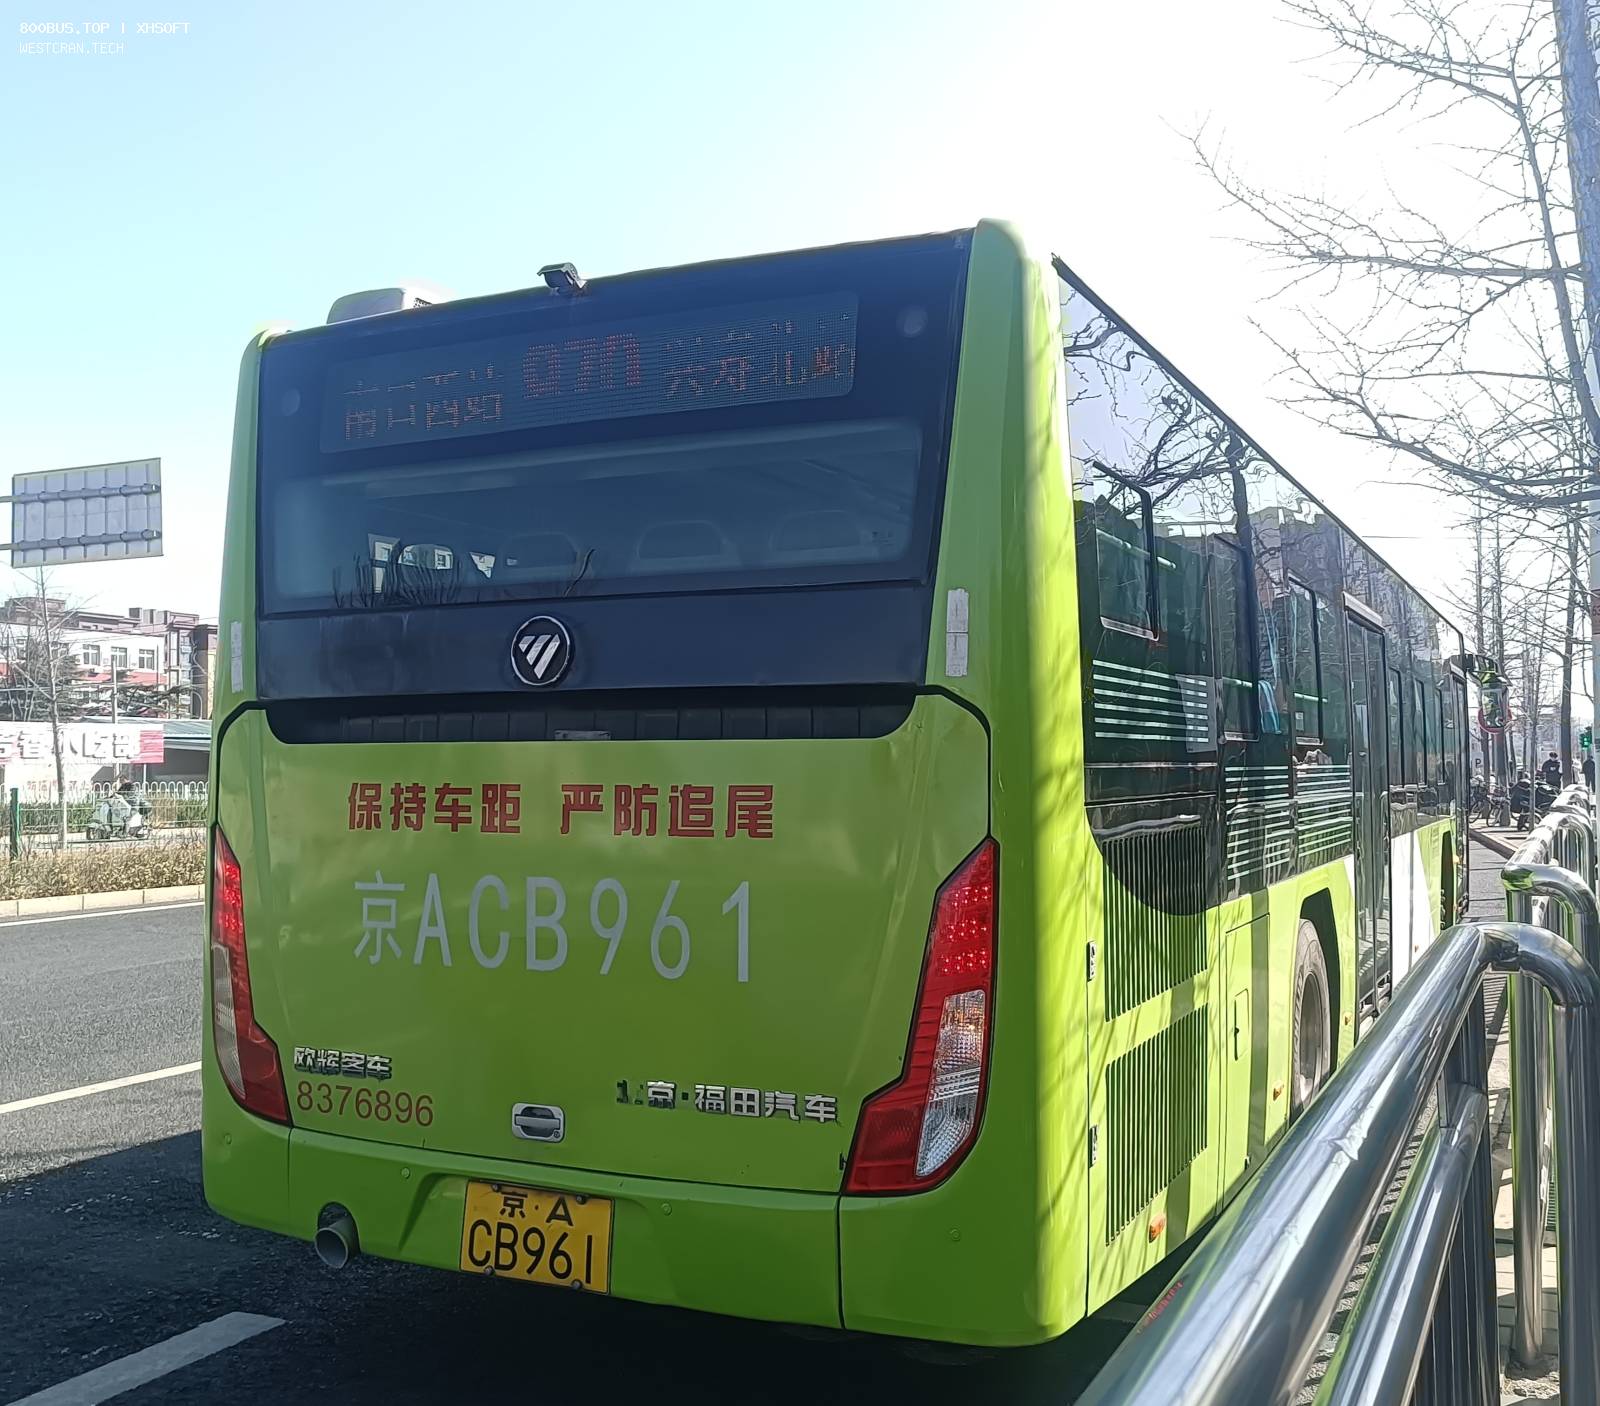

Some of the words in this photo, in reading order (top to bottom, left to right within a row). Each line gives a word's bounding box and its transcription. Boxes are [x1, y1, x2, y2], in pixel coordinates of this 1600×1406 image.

[348, 782, 521, 834] 保持车距
[560, 783, 774, 838] 严防追尾
[354, 870, 749, 982] 京ACB961
[297, 1081, 433, 1126] 8376896
[468, 1219, 593, 1284] CB961
